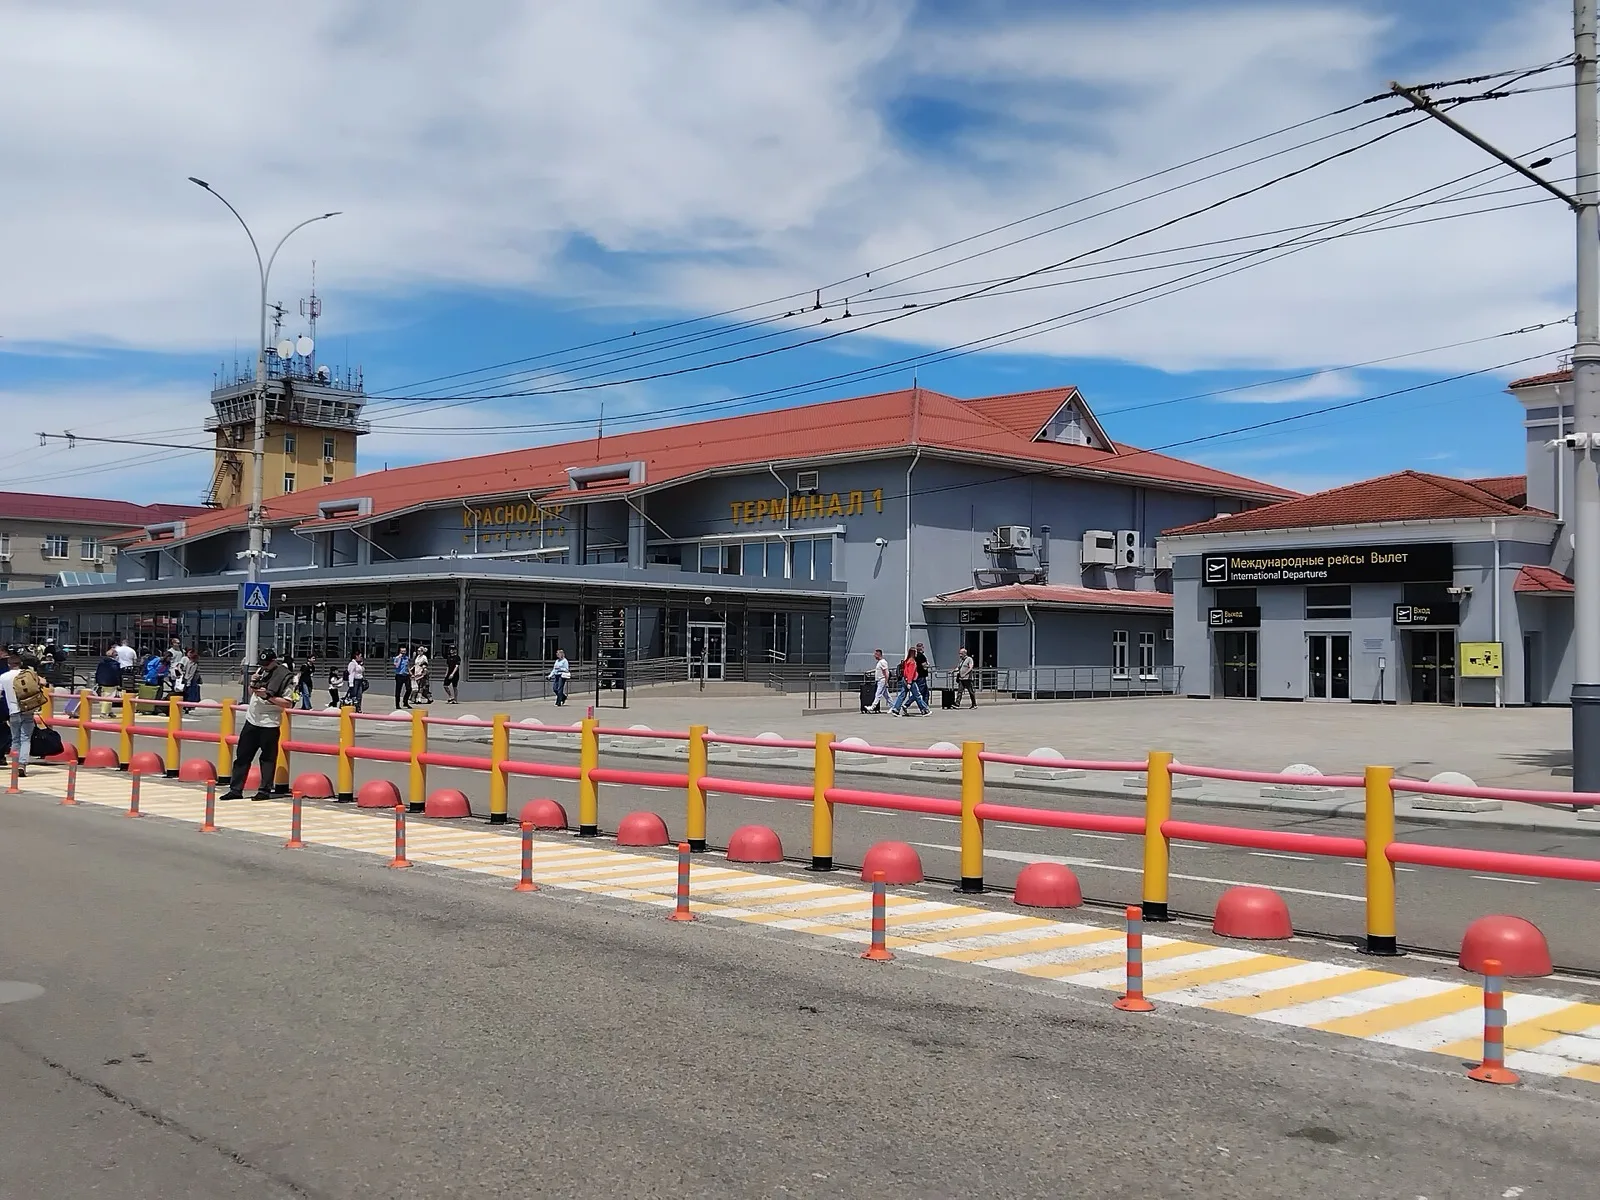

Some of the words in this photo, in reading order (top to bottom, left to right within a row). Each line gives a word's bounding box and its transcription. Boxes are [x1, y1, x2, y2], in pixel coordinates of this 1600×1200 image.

[730, 490, 864, 525] ТЕРМИНАЛ
[873, 488, 884, 513] 1
[1231, 556, 1324, 569] Международные
[1328, 555, 1365, 567] рейсы
[1371, 552, 1408, 563] Вылет
[1231, 571, 1280, 580] International
[1283, 570, 1328, 580] Departures
